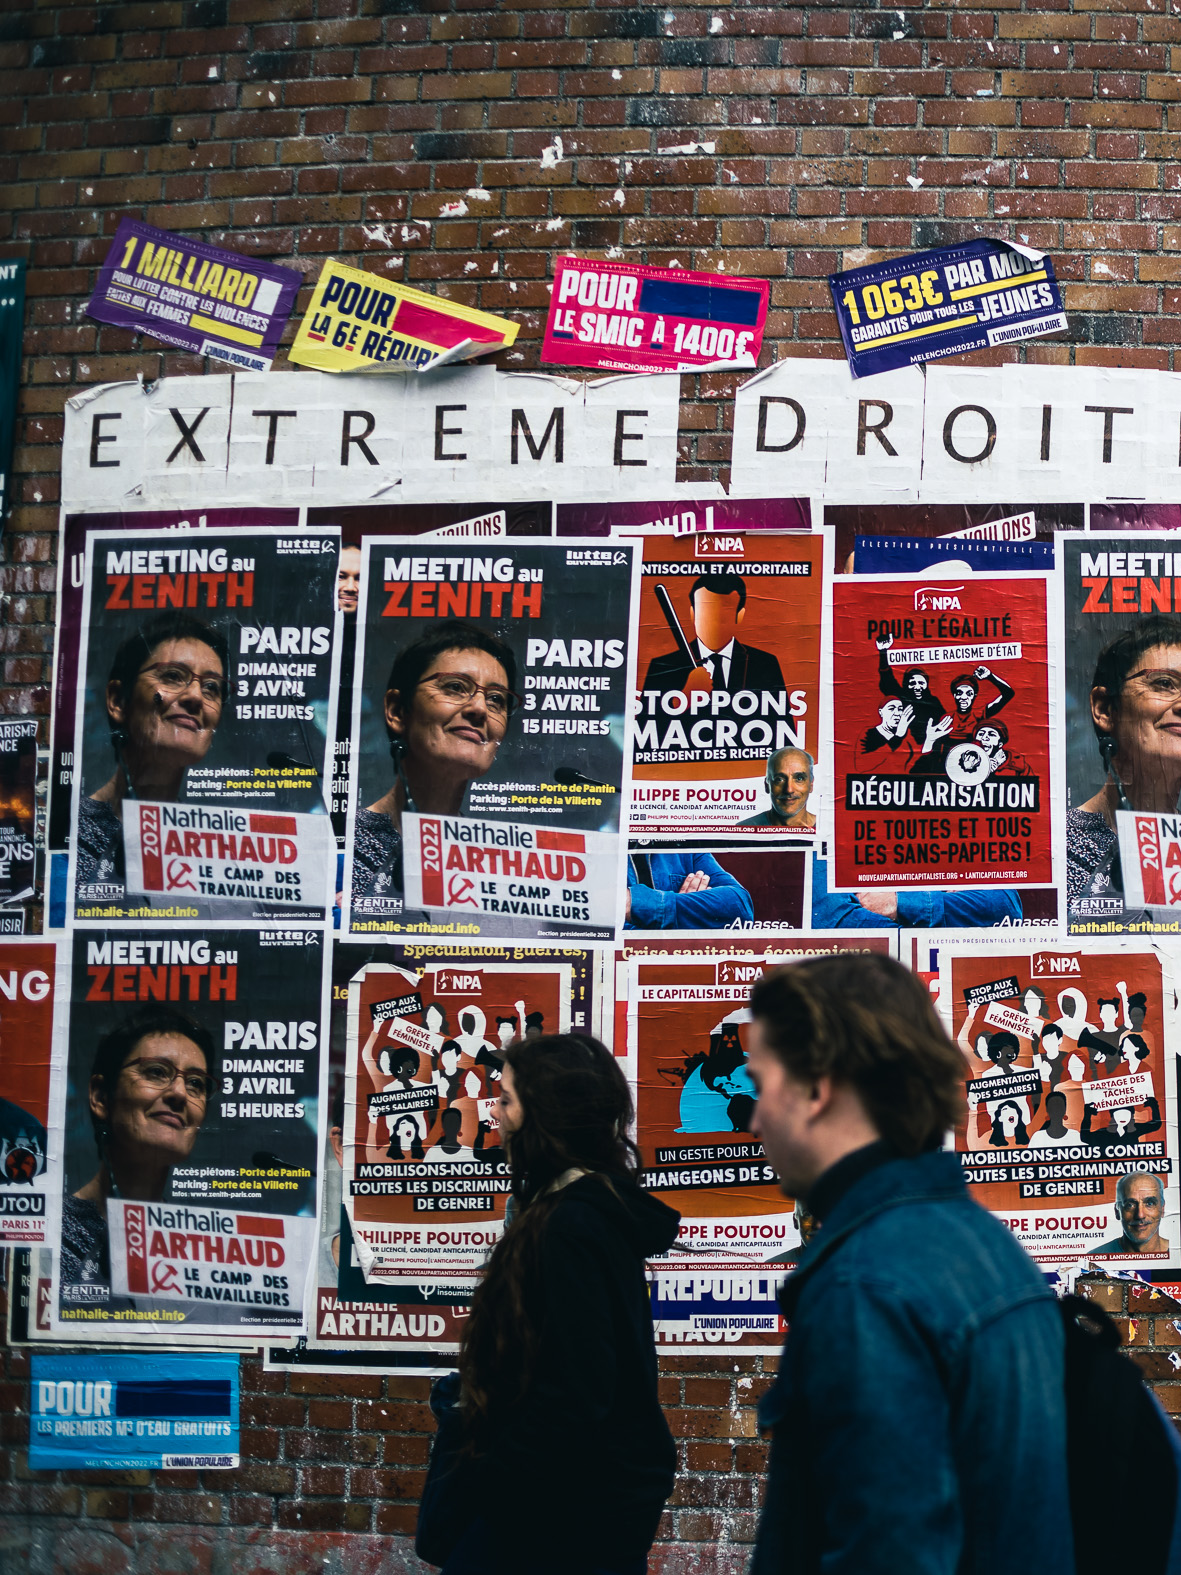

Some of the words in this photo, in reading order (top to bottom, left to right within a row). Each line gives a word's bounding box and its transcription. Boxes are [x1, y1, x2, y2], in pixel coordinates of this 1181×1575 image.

[120, 237, 138, 269] 1
[137, 242, 258, 307] MILLIARD
[944, 258, 987, 290] PAR
[112, 270, 131, 285] POUR
[133, 278, 160, 294] LUTTER
[159, 286, 199, 310] CONTRE
[214, 304, 269, 332] VIOLENCES
[320, 275, 396, 328] POUR
[558, 270, 638, 311] POUR
[107, 287, 131, 303] FAITES
[146, 301, 190, 325] FEMMES
[850, 316, 909, 342] GARANTIS
[910, 311, 933, 326] POUR
[934, 306, 957, 321] TOUS
[959, 301, 974, 314] LES
[977, 283, 1054, 322] JEUNES
[310, 313, 331, 335] LA
[553, 309, 575, 332] LE
[578, 312, 644, 347] SMIC
[652, 316, 665, 342] À
[673, 322, 754, 360] 1400€
[134, 325, 200, 351] MELENCHON2022.FR
[910, 339, 987, 363] MELENCHON2022.FR
[992, 329, 1021, 344] L'UNION
[1022, 319, 1062, 338] POPULAIRE
[89, 404, 649, 468] EXTREME
[106, 549, 227, 574] MEETING
[384, 557, 513, 582] MEETING
[726, 564, 809, 574] AUTORITAIRE
[105, 572, 255, 610] ZENITH
[382, 582, 542, 618] ZENITH
[868, 619, 914, 640] POUR
[923, 613, 1012, 638] L'ÉGALITÉ
[239, 627, 331, 655] PARIS
[526, 639, 624, 668] PARIS
[889, 651, 925, 663] CONTRE
[943, 648, 984, 660] RACISME
[987, 645, 1017, 657] D'ÉTAT
[524, 676, 610, 690] DIMANCHE
[541, 694, 600, 711] AVRIL
[542, 719, 610, 735] HEURES
[635, 720, 806, 749] MACRON
[635, 749, 701, 763] PRÉSIDENT
[704, 749, 727, 760] DES
[730, 748, 772, 759] RICHES
[687, 789, 756, 801] POUTOU
[851, 776, 1035, 808] RÉGULARISATION
[855, 820, 876, 841] DE
[884, 819, 950, 840] TOUTES
[959, 818, 978, 838] ET
[986, 817, 1031, 838] TOUS
[165, 831, 297, 864] ARTHAUD
[855, 844, 887, 865] LES
[1138, 821, 1158, 870] 2022
[445, 845, 586, 882] ARTHAUD
[77, 906, 198, 917] nathalie-arthaud.info
[87, 940, 210, 965] MEETING
[1050, 958, 1080, 972] NPA
[86, 966, 237, 1001] ZENITH
[656, 989, 730, 999] CAPITALISME
[970, 985, 991, 997] STOP
[993, 980, 1012, 991] AUX
[224, 1021, 317, 1051] PARIS
[970, 1073, 1039, 1091] AUGMENTATION
[1090, 1079, 1129, 1090] PARTAGE
[370, 1088, 437, 1104] AUGMENTATION
[679, 1148, 714, 1161] GESTE
[717, 1146, 748, 1158] POUR
[961, 1146, 1101, 1166] MOBILISONS-NOUS
[1105, 1143, 1162, 1157] CONTRE
[1039, 1159, 1170, 1178] DISCRIMINATIONS
[714, 1226, 786, 1239] POUTOU
[149, 1231, 285, 1268] ARTHAUD
[320, 1314, 445, 1337] ARTHAUD
[38, 1380, 112, 1416] POUR
[55, 1421, 112, 1436] PREMIERS
[174, 1421, 231, 1436] GRATUITS
